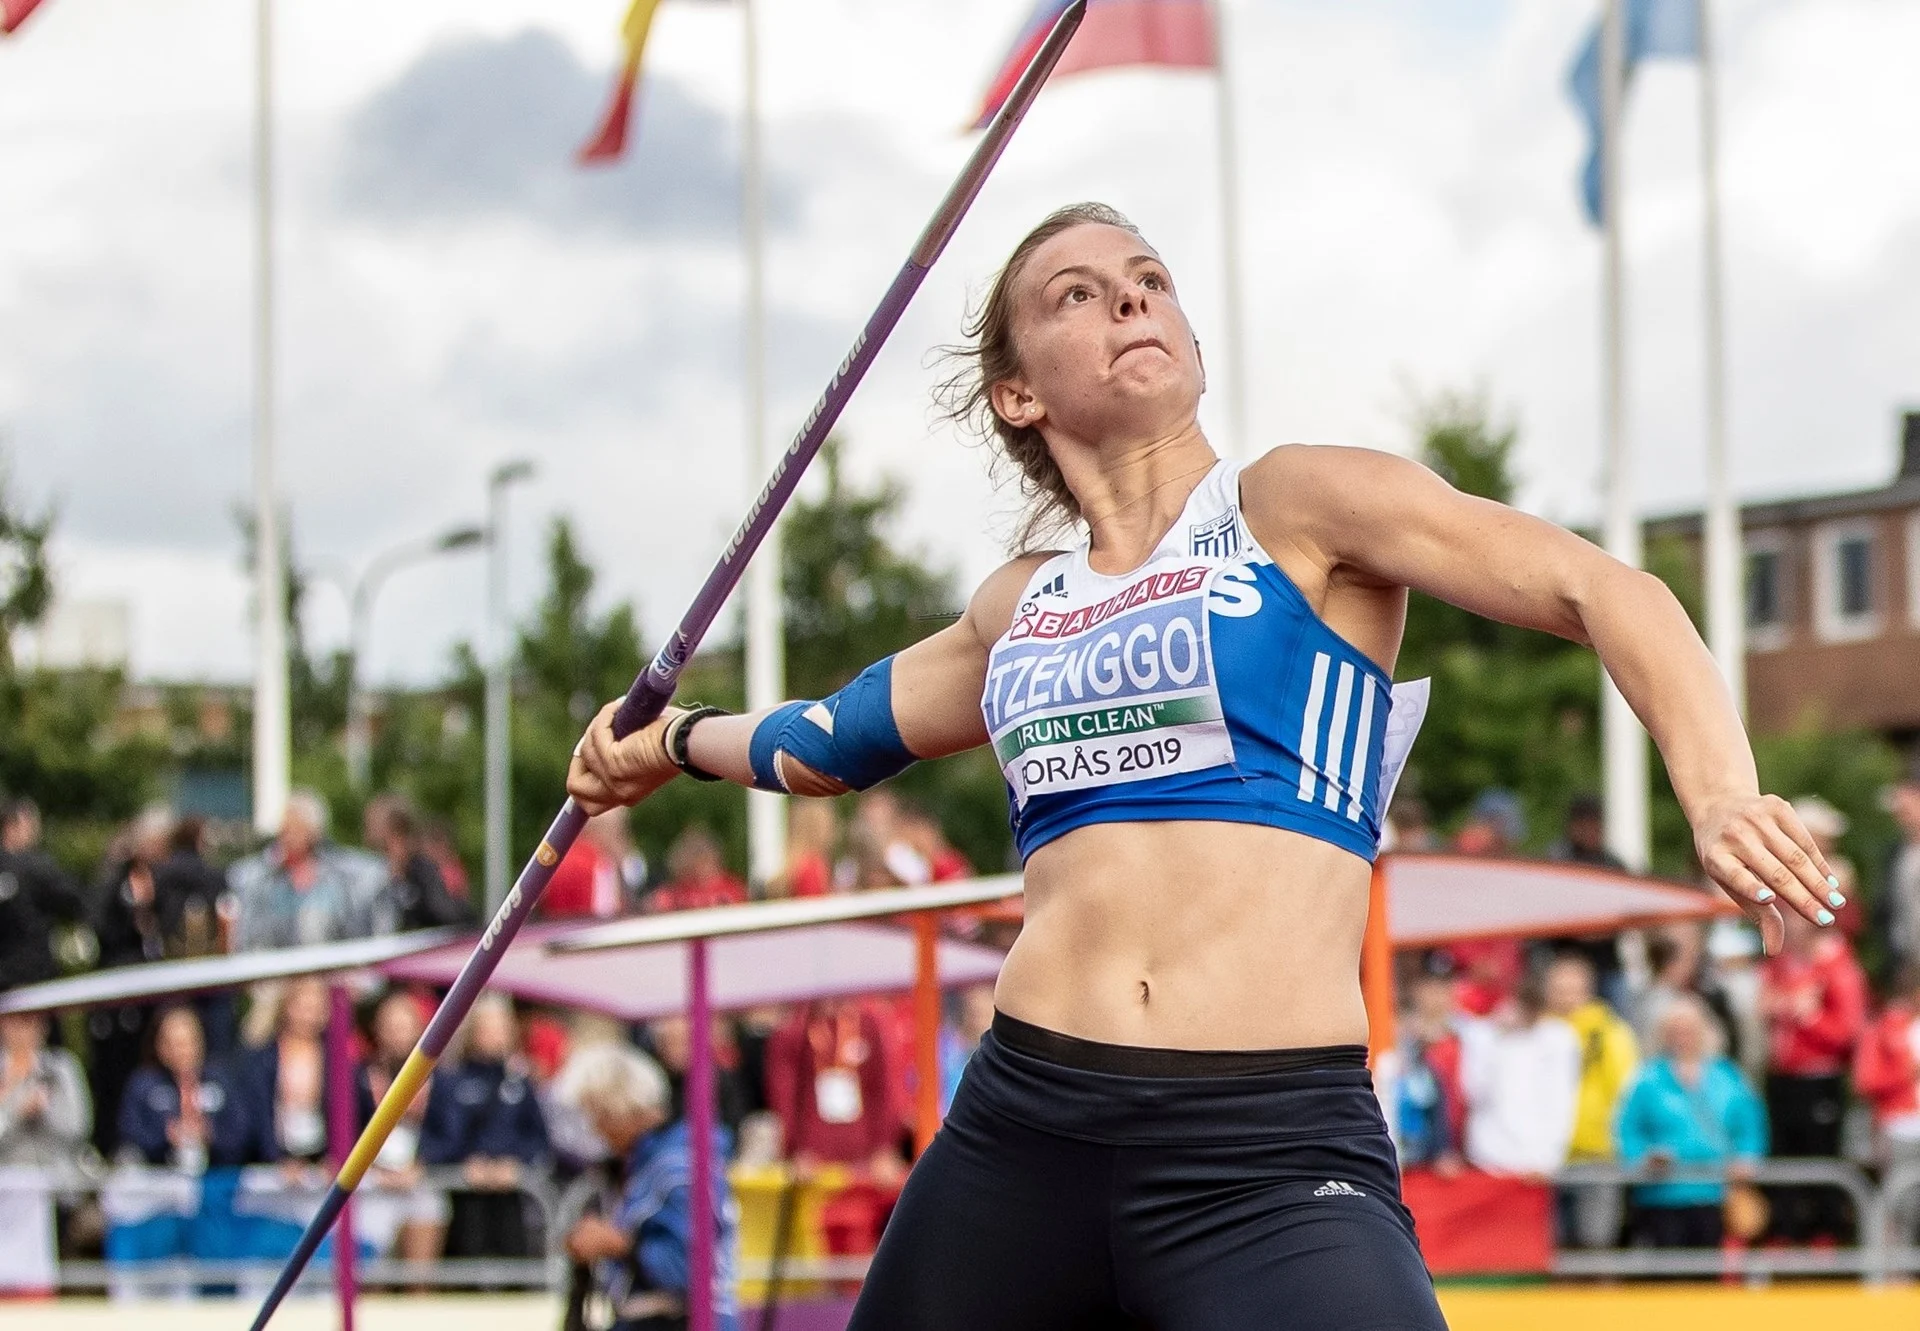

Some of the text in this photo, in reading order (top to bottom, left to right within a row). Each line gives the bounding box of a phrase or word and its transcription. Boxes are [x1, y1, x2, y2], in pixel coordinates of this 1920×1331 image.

[1036, 568, 1208, 635] BAUHAUS
[990, 616, 1199, 726] TZÉNGGO
[1022, 718, 1072, 746] RUN
[1117, 737, 1182, 773] 2019
